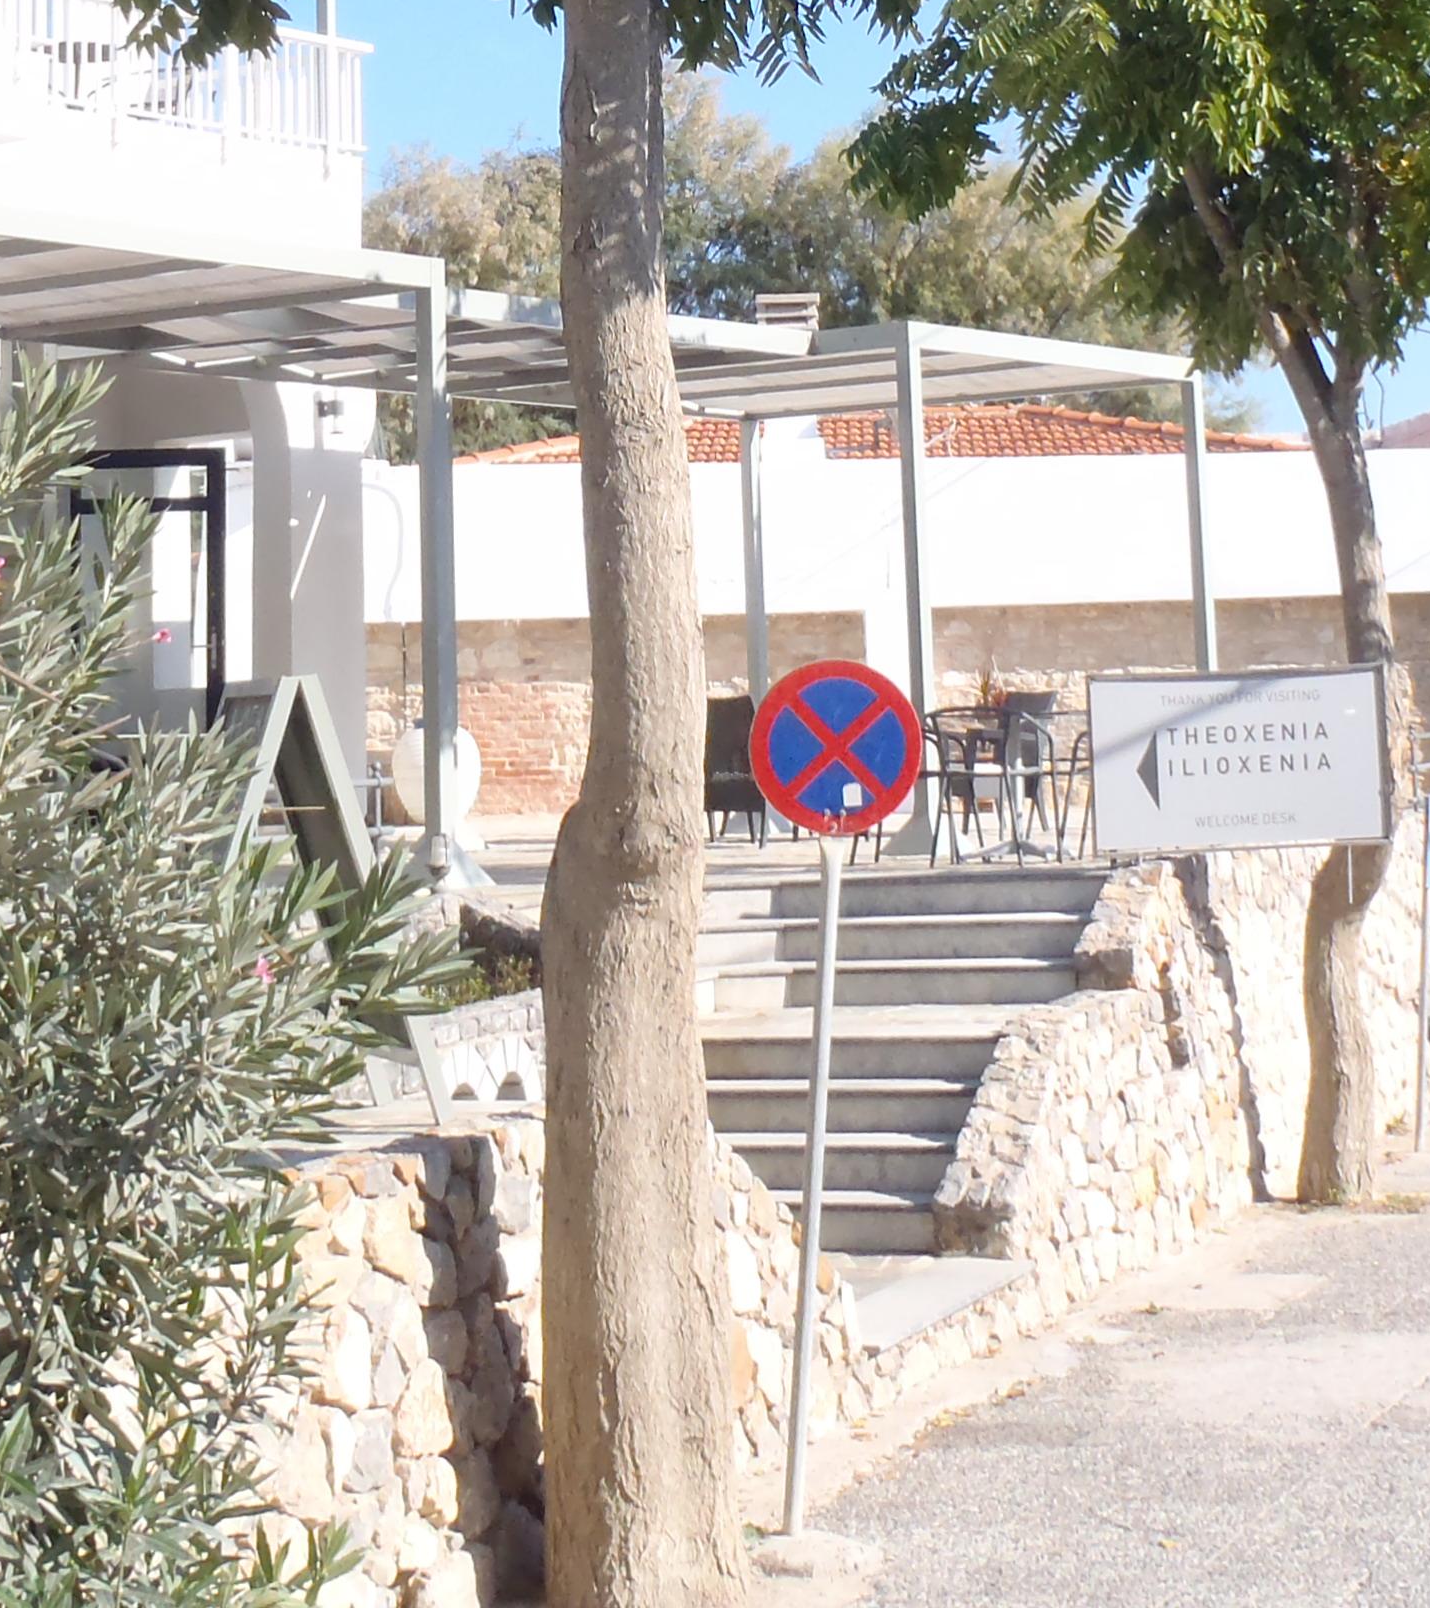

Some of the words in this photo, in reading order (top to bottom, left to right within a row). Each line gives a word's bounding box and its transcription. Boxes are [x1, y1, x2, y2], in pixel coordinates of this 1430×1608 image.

[1159, 694, 1205, 708] THANK
[1208, 691, 1234, 706] YOU
[1236, 690, 1263, 705] FOR
[1266, 688, 1321, 704] VISITING
[1166, 722, 1329, 746] THEOXENIA
[1168, 752, 1332, 777] ILIOXENIA
[1194, 813, 1260, 829] WELCOME
[1262, 811, 1298, 826] DESK
